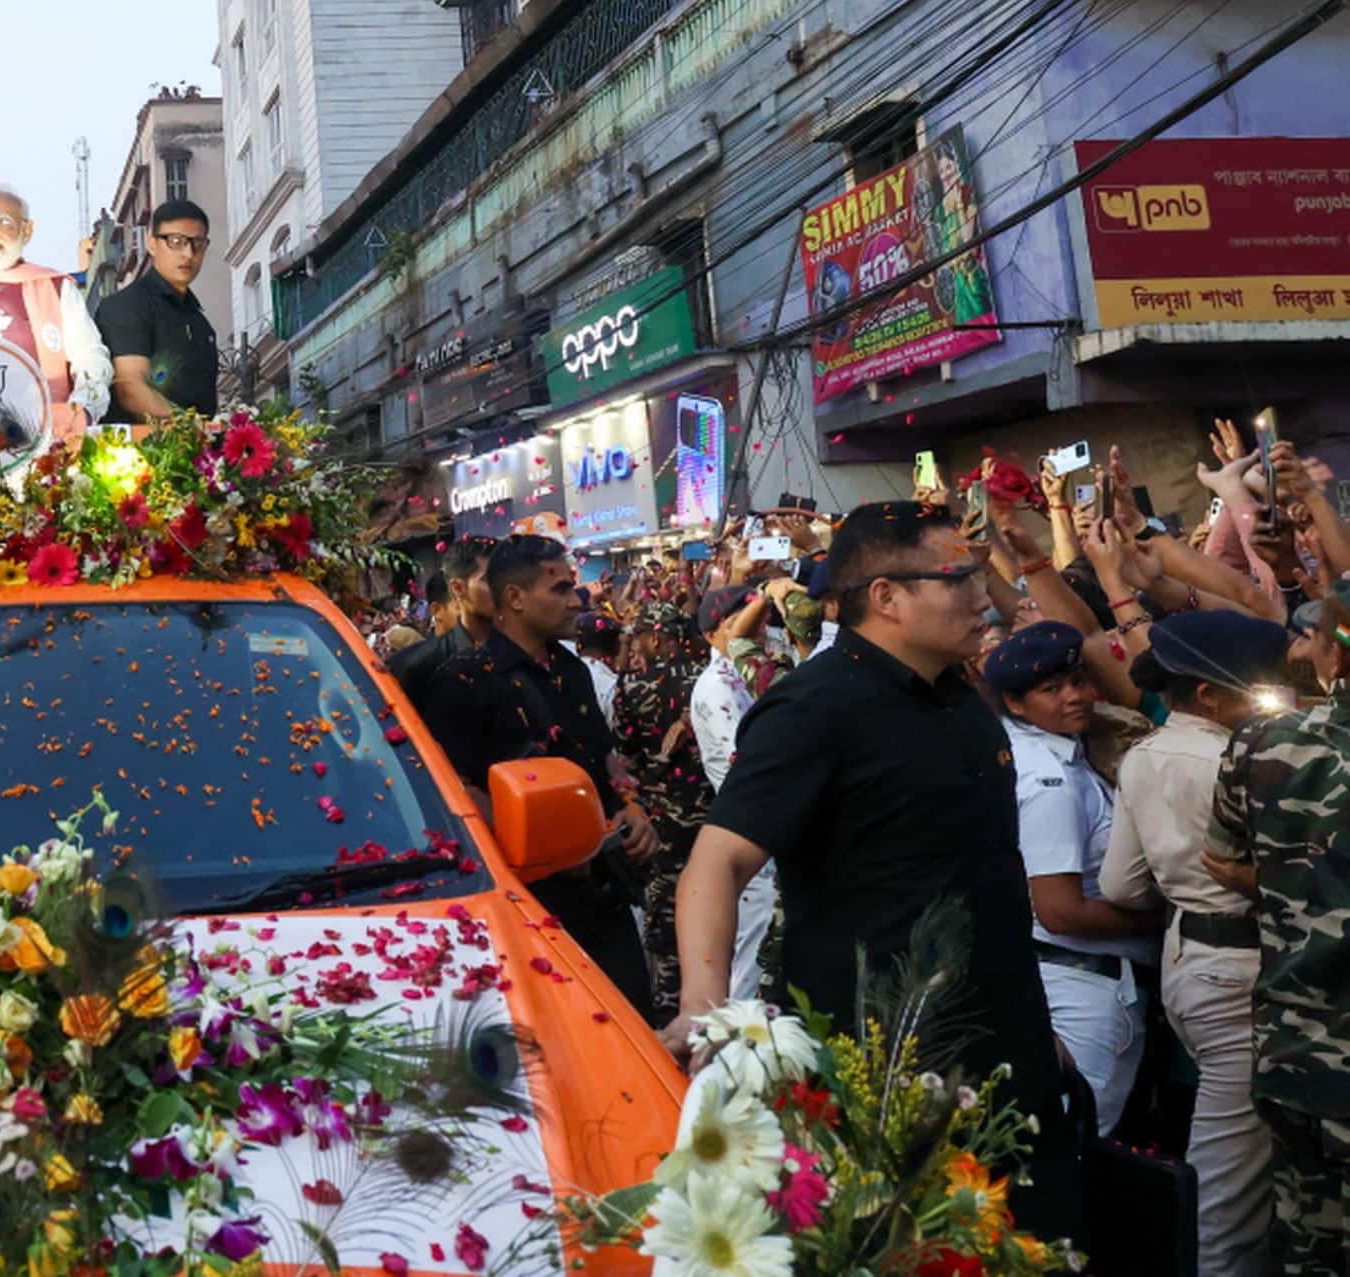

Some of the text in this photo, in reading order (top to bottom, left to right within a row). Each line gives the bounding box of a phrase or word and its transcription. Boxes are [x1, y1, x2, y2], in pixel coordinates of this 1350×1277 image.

[803, 166, 907, 252] SIMMY
[1145, 191, 1203, 225] pnb
[1131, 286, 1245, 316] লিলুয়া শাখা
[1272, 284, 1336, 315] लिलुआ
[562, 304, 639, 379] oppo
[451, 477, 510, 515] Crompton
